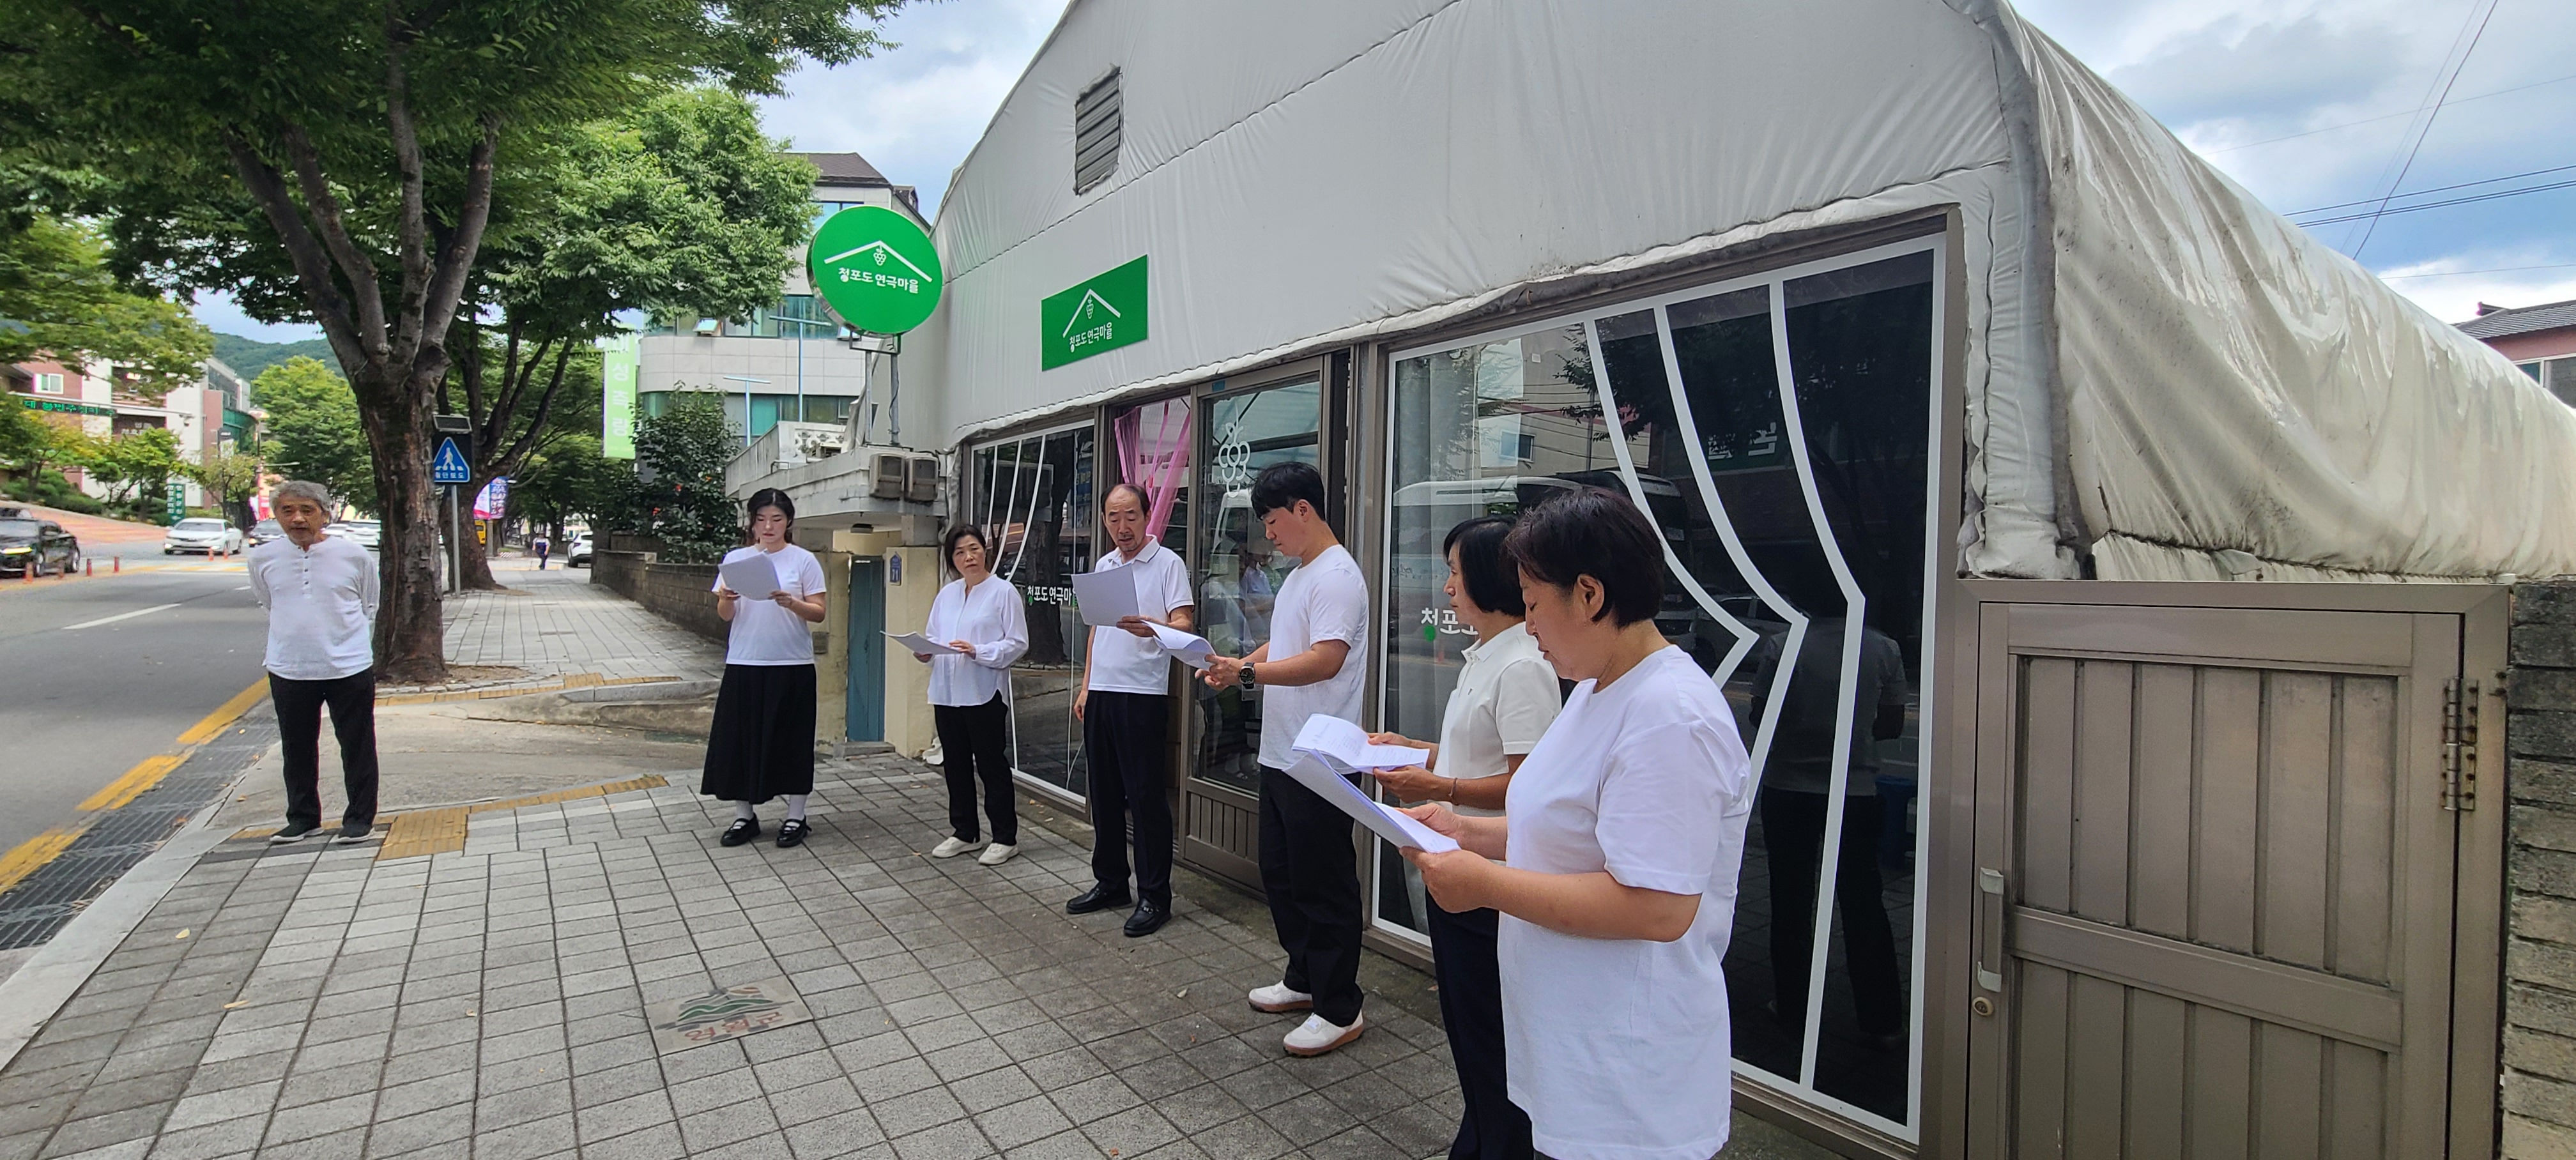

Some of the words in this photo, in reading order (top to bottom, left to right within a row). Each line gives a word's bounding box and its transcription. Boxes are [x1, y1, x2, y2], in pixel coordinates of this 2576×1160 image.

[838, 267, 873, 282] 청포도
[875, 273, 919, 294] 연극마을
[1070, 332, 1087, 353] 청포도
[1087, 322, 1112, 344] 연극마을
[1027, 585, 1048, 606] 청포도
